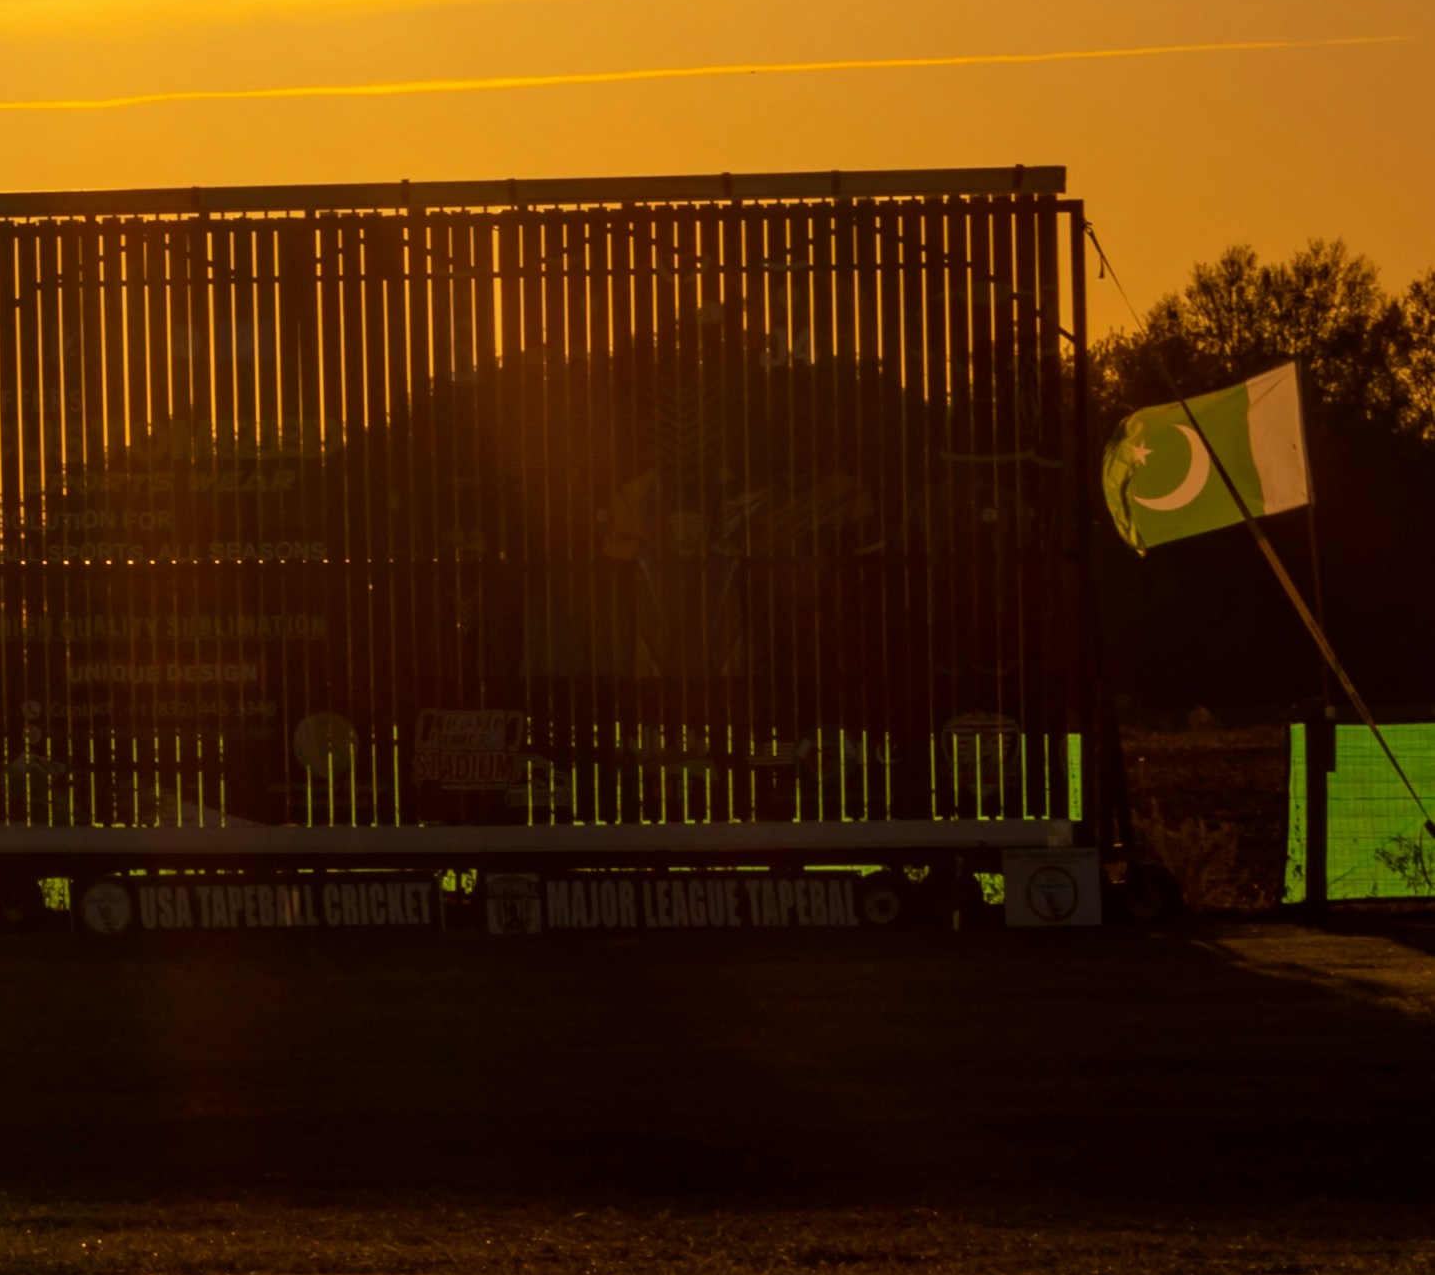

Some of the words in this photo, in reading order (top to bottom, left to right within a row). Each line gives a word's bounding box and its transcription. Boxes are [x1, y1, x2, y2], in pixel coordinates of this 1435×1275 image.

[187, 469, 298, 493] WEAR
[69, 664, 160, 683] UNIQUE
[165, 663, 257, 682] DESIGN
[138, 884, 193, 929] USA
[196, 883, 319, 928] TAPEBALL
[322, 881, 432, 926] CRICKET
[546, 881, 637, 929] MAJOR
[642, 880, 742, 928] LEAGUE
